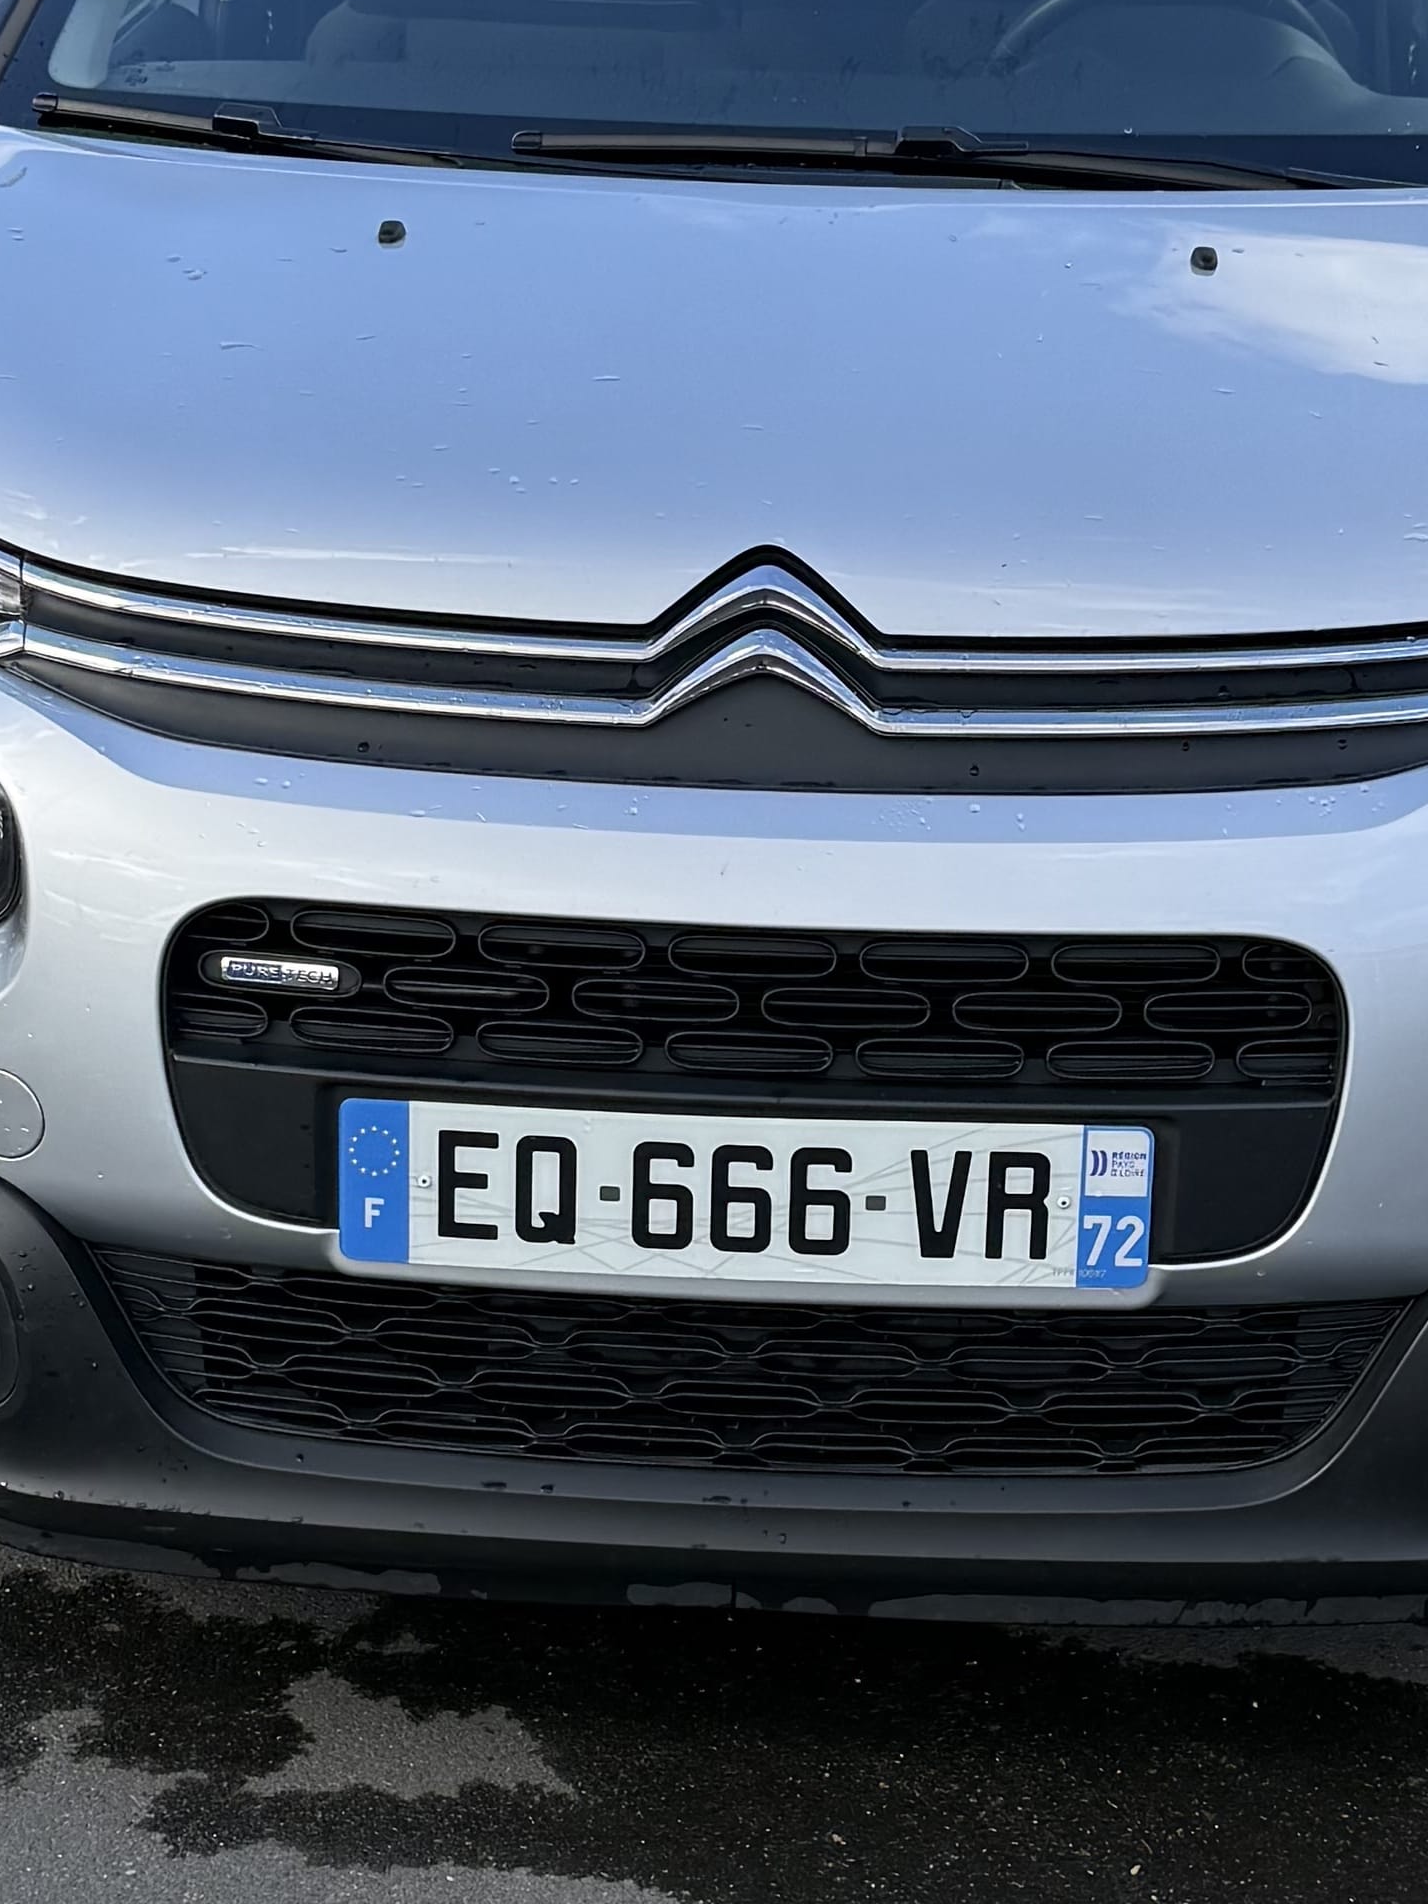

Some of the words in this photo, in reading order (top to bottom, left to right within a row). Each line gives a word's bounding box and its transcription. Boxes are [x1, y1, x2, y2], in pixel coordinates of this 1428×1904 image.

[365, 1198, 383, 1228] F
[438, 1130, 1051, 1260] EQ-666-VR
[1083, 1215, 1145, 1267] 72
